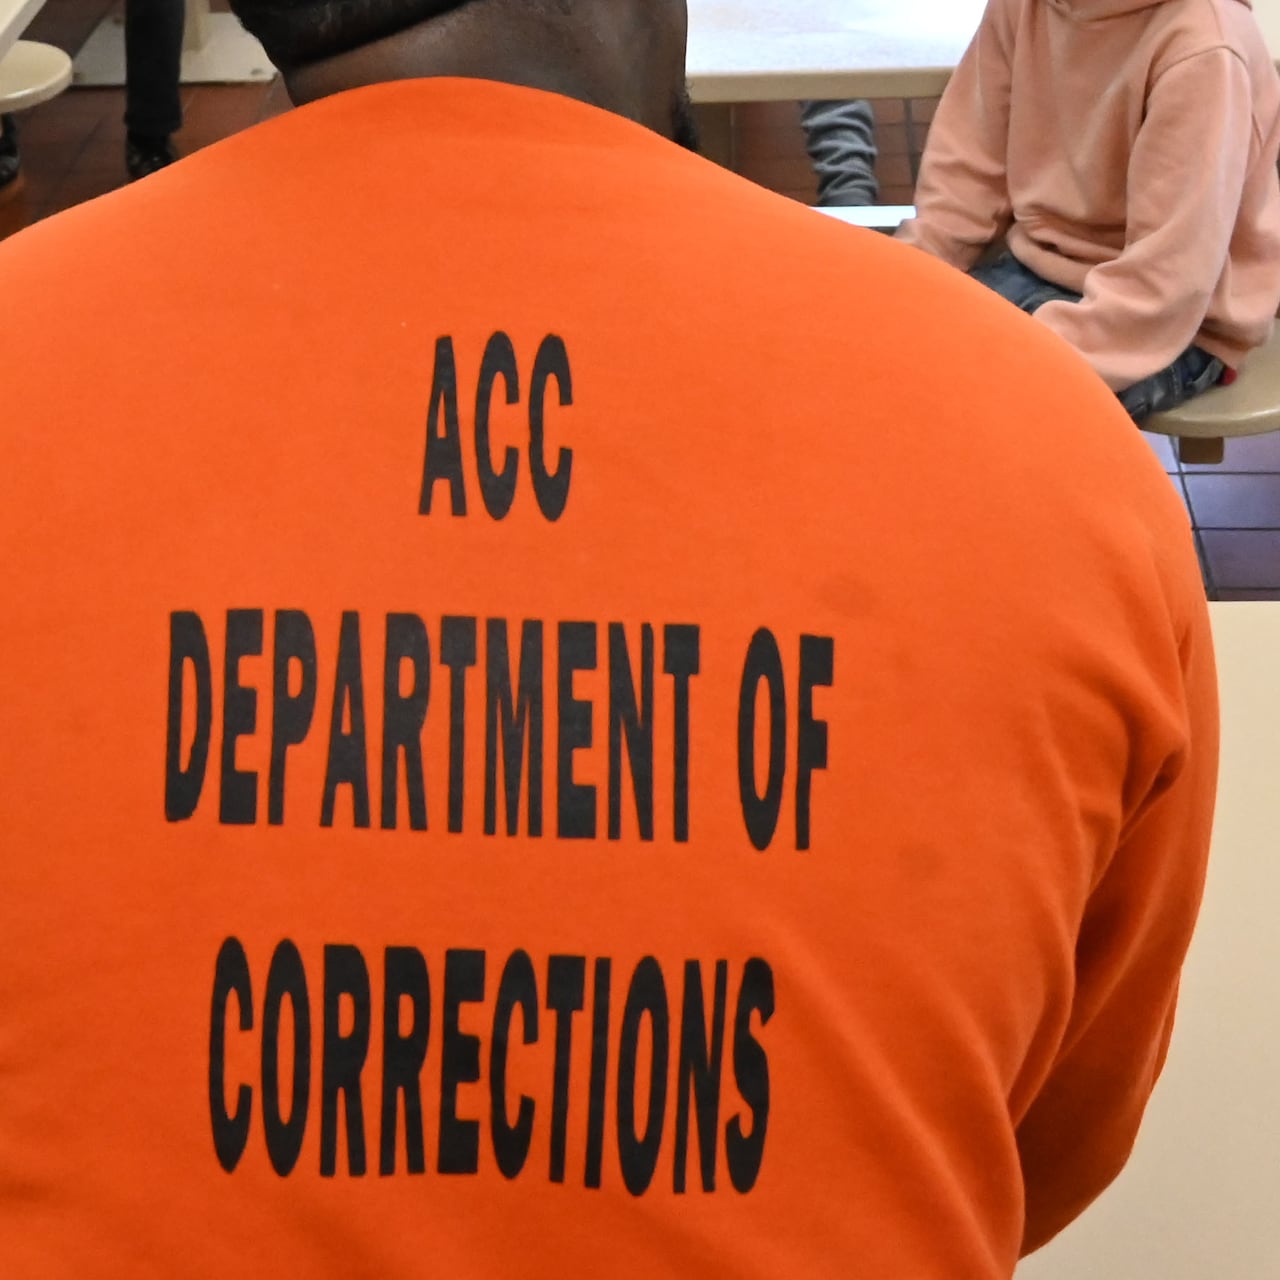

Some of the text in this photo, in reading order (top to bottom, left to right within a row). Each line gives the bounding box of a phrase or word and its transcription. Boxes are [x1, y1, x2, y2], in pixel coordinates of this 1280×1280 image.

[419, 331, 573, 521] ACC
[163, 609, 834, 851] DEPARTMENT OF
[207, 936, 775, 1197] CORRECTIONS
